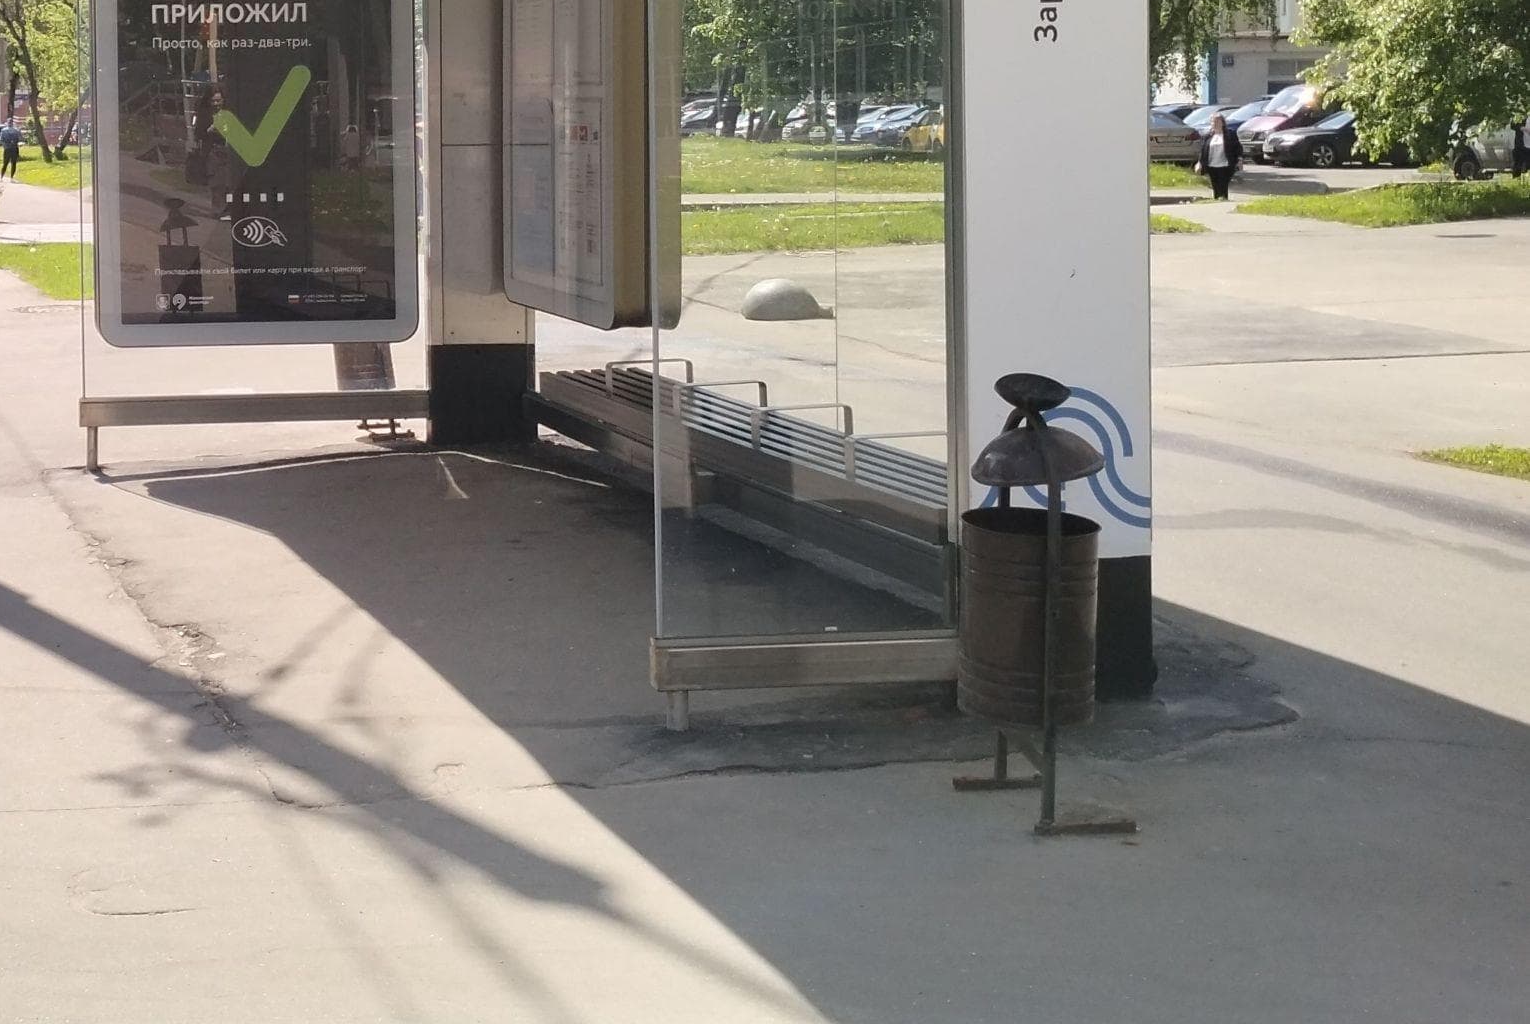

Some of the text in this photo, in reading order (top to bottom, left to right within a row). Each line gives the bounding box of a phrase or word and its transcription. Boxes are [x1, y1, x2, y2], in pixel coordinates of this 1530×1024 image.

[151, 2, 307, 24] ПРИЛОЖИЛ
[152, 37, 312, 50] Просто, как раз-два-три.
